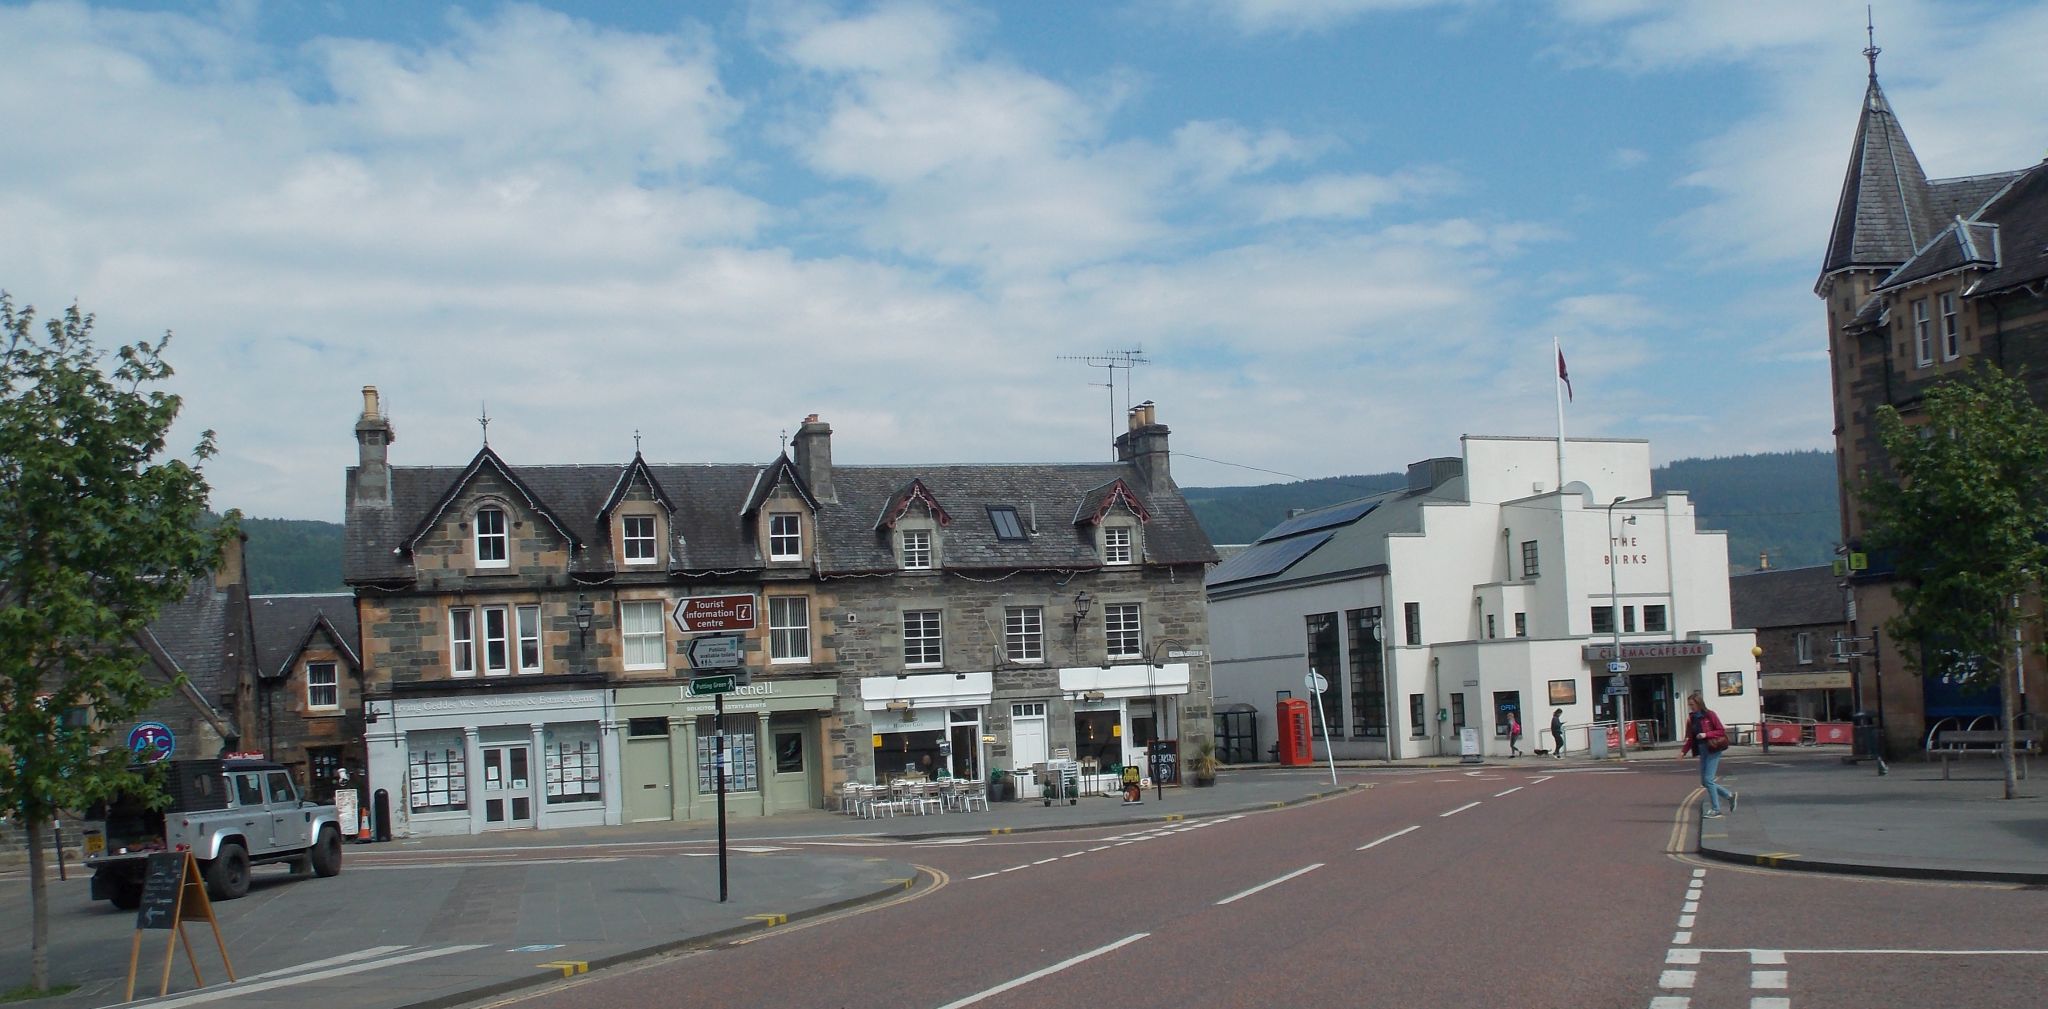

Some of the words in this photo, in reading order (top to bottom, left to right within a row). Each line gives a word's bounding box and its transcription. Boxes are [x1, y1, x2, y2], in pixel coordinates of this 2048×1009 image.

[1611, 537, 1637, 547] THE
[1604, 554, 1647, 565] BIRKS
[695, 600, 724, 609] Tourist
[686, 609, 734, 619] information
[697, 620, 724, 628] centre
[1600, 648, 1645, 659] CIEMA
[696, 682, 713, 690] Putting
[724, 682, 773, 696] tchell
[1151, 753, 1177, 763] BEAKFAST
